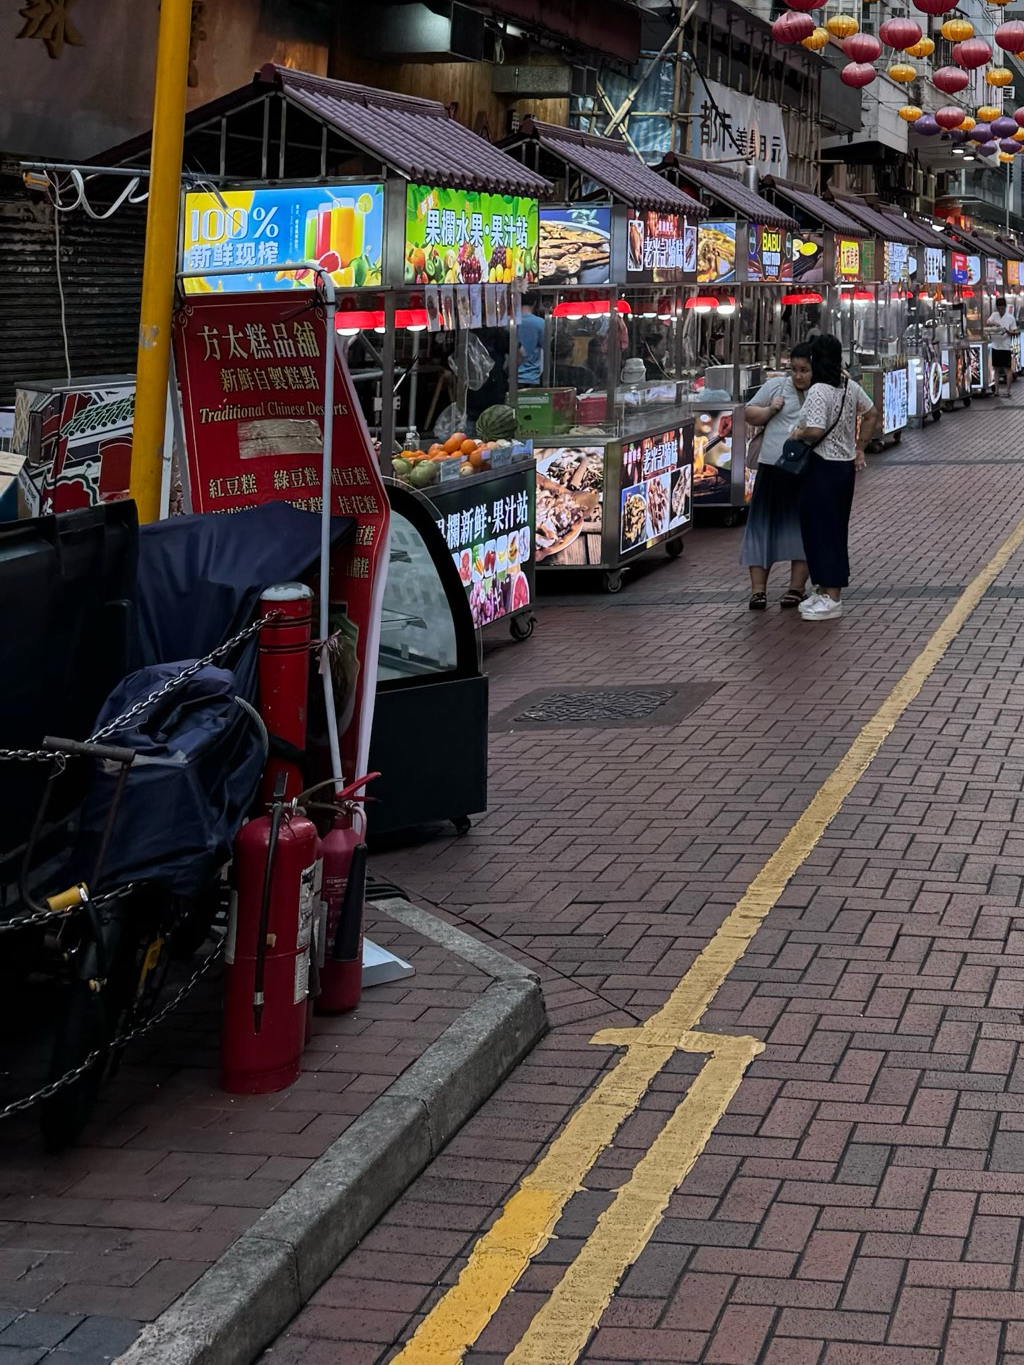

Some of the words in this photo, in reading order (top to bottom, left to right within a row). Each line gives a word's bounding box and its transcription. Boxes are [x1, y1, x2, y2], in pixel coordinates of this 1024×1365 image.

[191, 206, 281, 243] 100%
[190, 241, 279, 269] 新鲜现榨
[200, 402, 265, 424] Traditional
[267, 401, 306, 417] Chinese
[306, 400, 348, 416] Desrts
[208, 473, 258, 499] 紅豆糕
[273, 467, 320, 491] 綠豆糕
